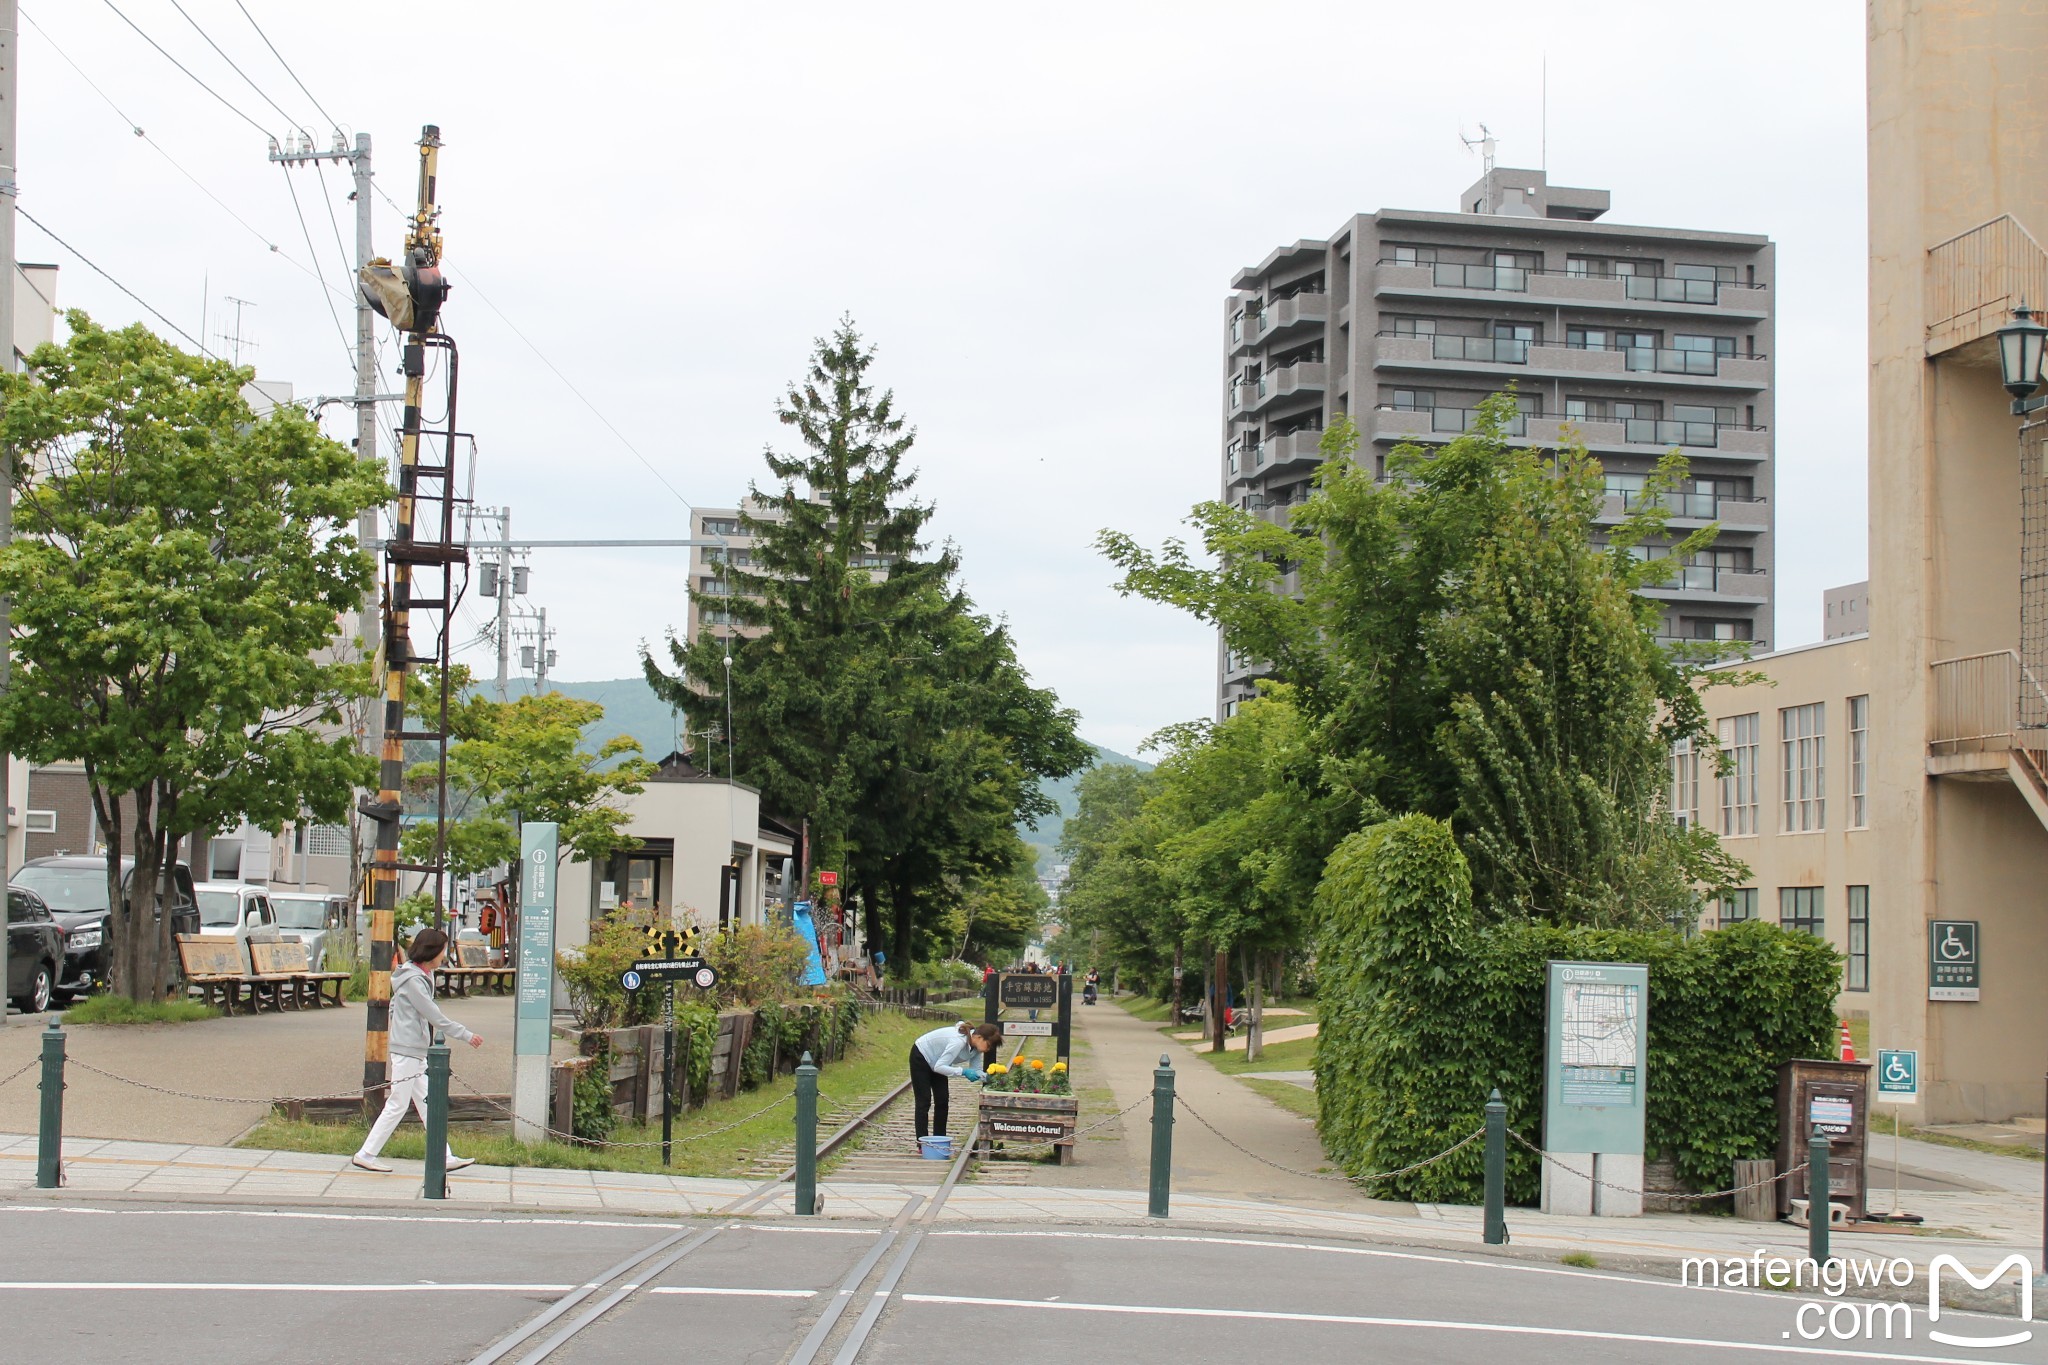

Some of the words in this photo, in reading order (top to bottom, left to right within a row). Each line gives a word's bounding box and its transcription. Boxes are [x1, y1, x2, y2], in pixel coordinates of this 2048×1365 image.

[993, 1122, 1027, 1133] Welcome
[1027, 1125, 1036, 1133] to
[1036, 1125, 1061, 1135] Otaru!
